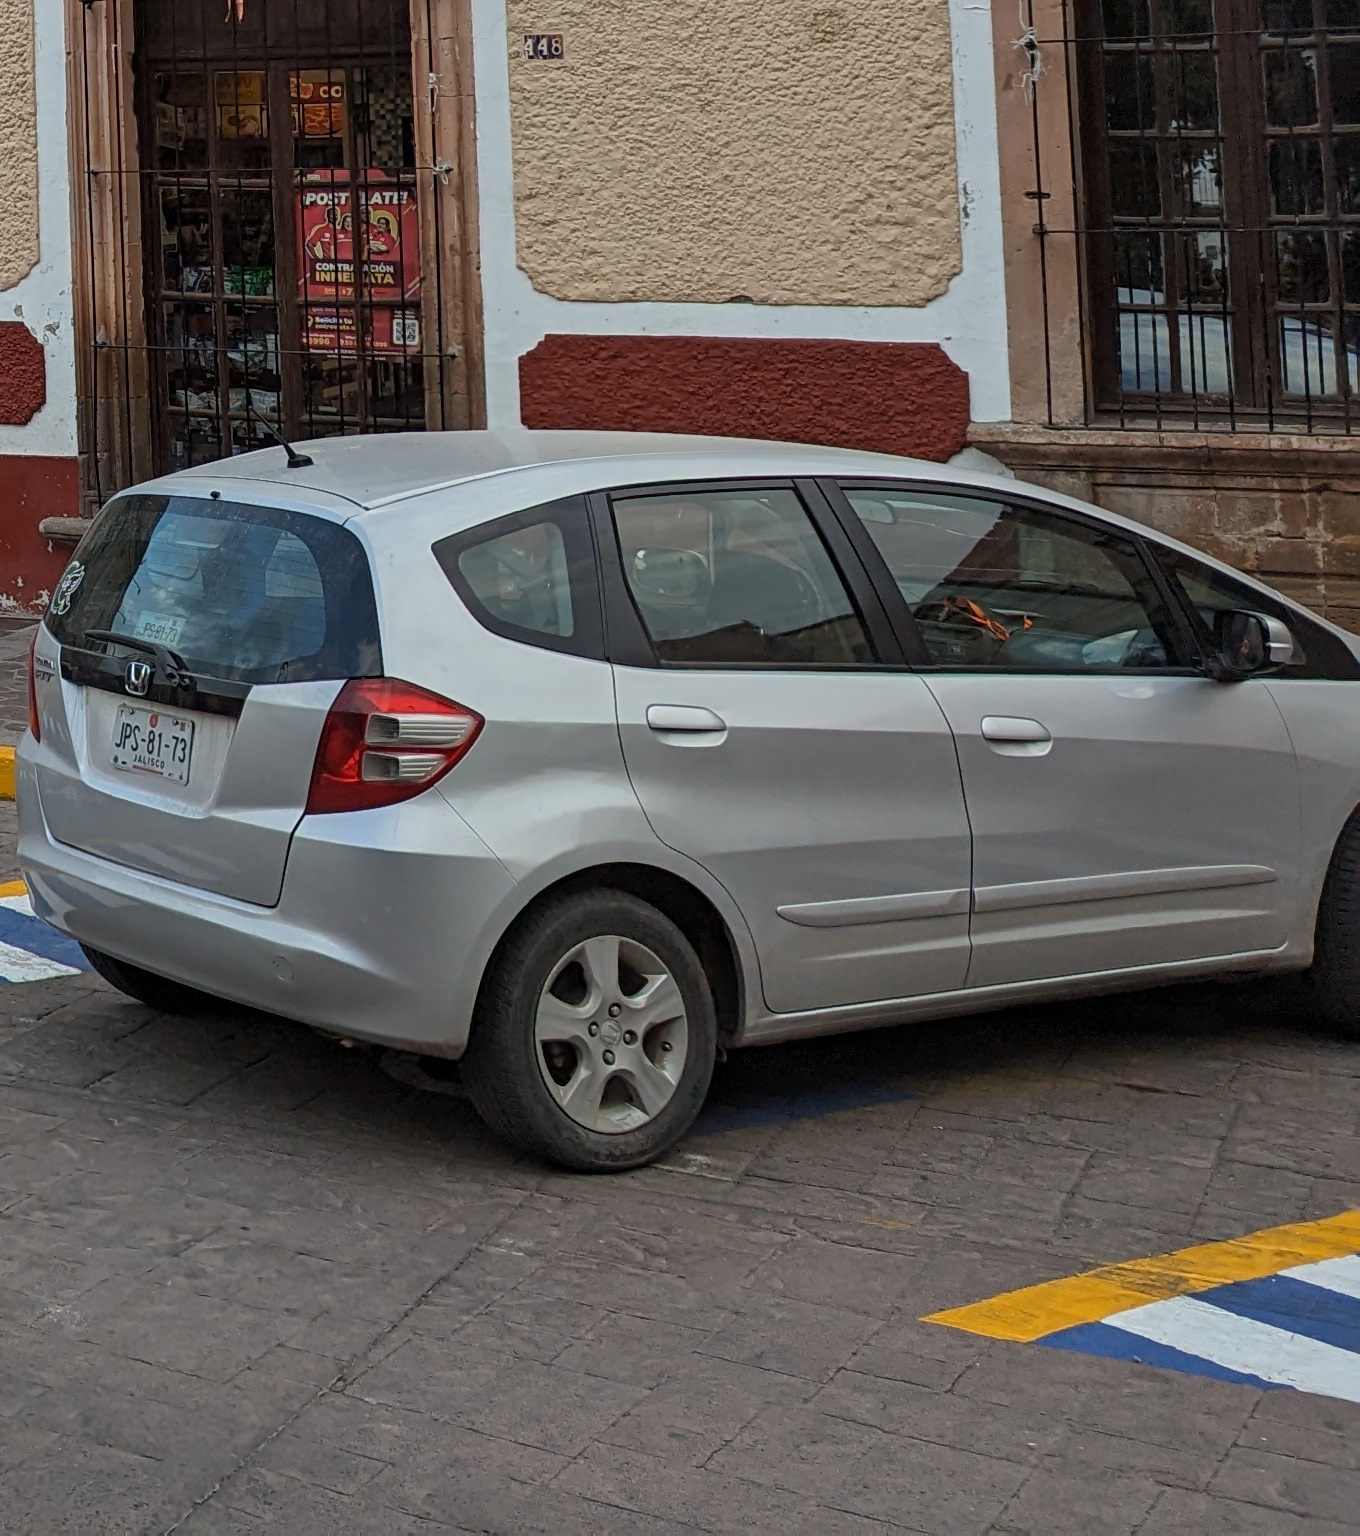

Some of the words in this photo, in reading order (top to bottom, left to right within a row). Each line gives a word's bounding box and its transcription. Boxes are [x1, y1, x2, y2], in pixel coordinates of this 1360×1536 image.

[523, 37, 562, 56] 448
[302, 191, 409, 206] ¡POSTLATE!
[115, 722, 187, 763] JPS-81-73
[133, 754, 166, 770] JALISCO
